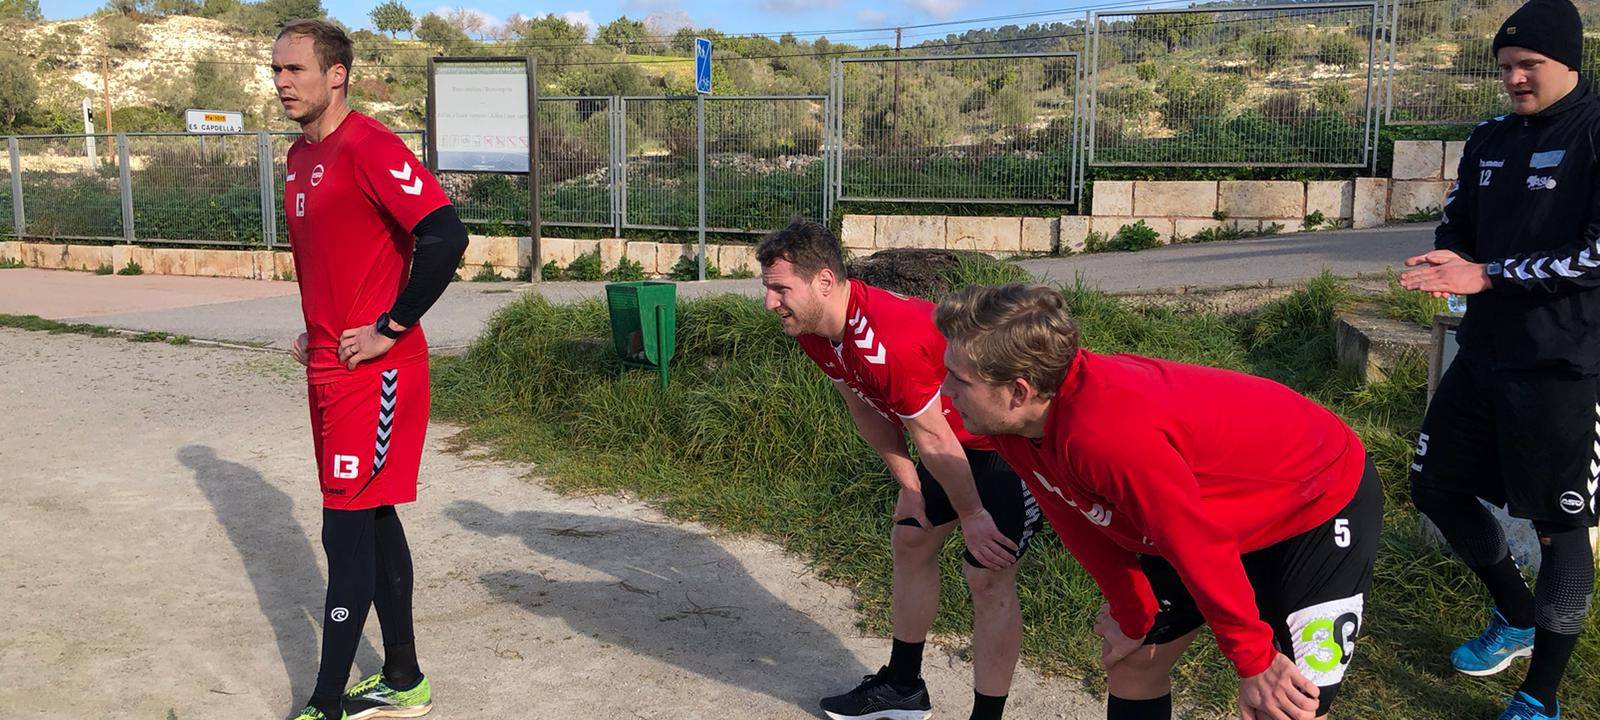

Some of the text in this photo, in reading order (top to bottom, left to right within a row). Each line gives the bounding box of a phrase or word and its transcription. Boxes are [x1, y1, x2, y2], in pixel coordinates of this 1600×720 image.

[1479, 169, 1493, 186] 12
[333, 454, 360, 479] 13
[1334, 518, 1351, 548] 5
